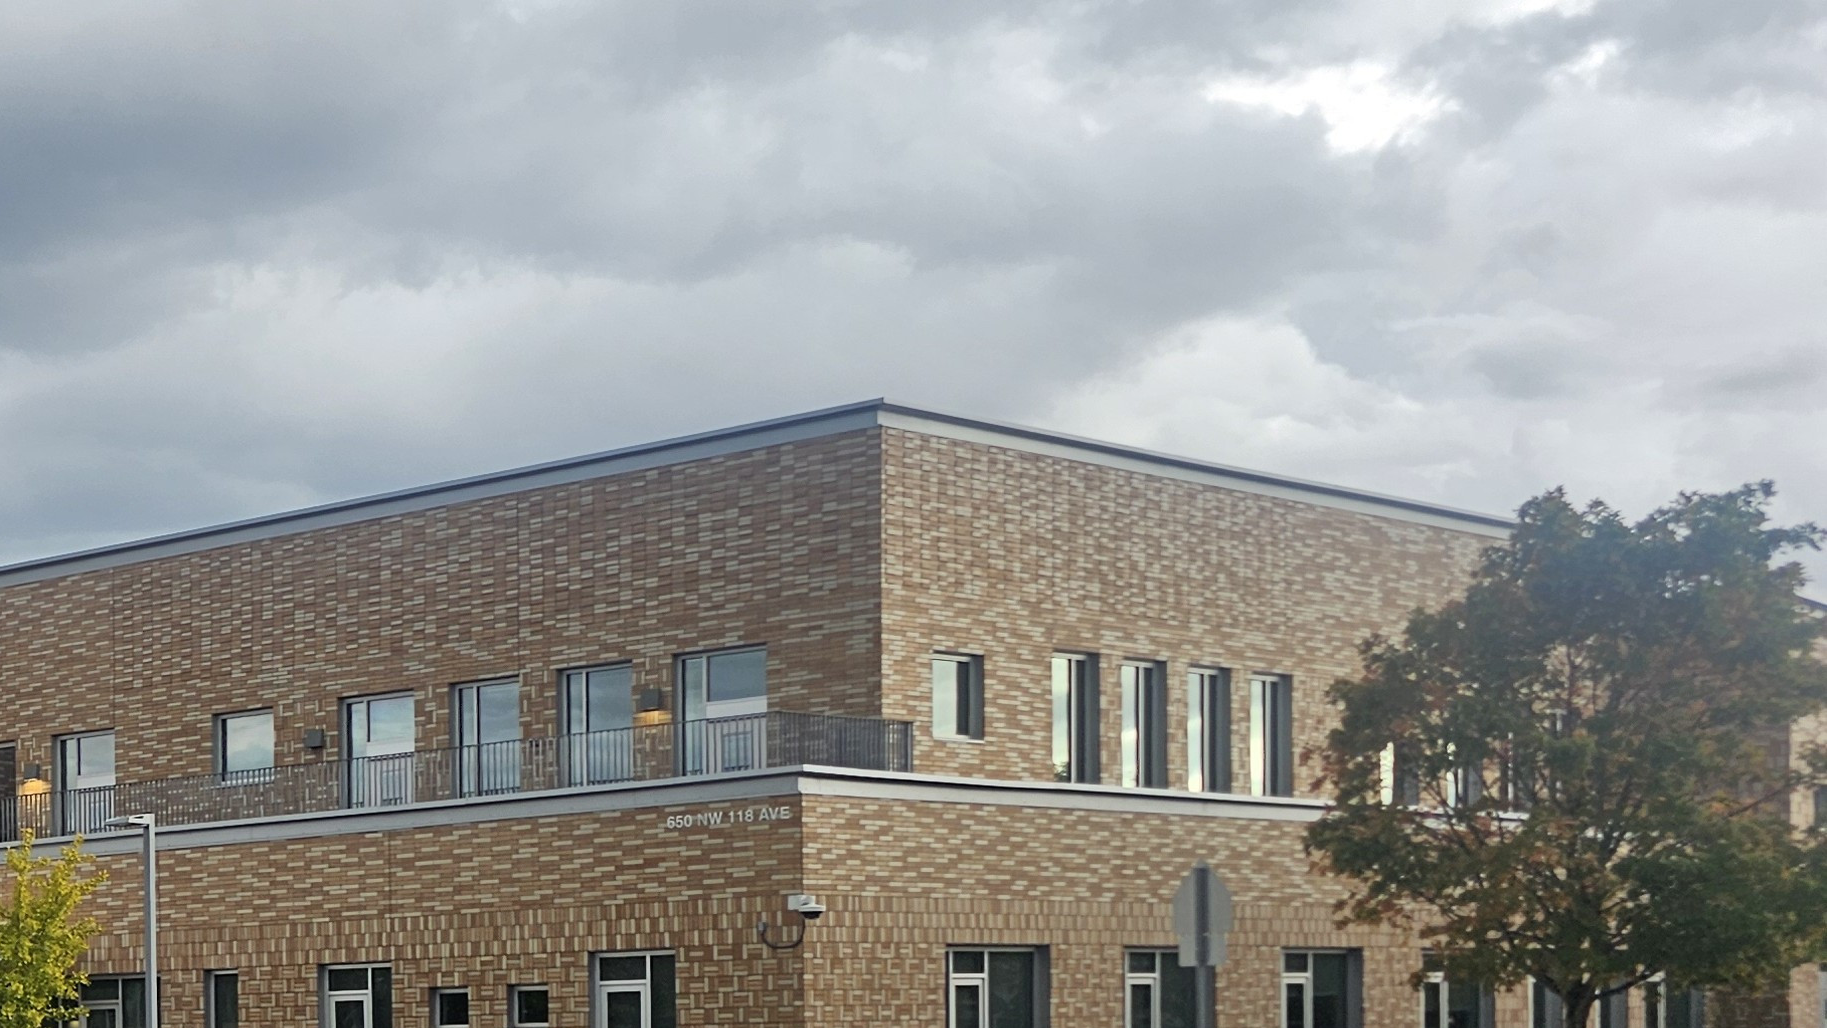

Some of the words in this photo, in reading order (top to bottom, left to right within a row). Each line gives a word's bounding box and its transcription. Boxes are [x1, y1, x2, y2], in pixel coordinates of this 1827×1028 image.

[667, 814, 692, 829] 650
[697, 811, 723, 826] NW
[728, 809, 754, 823] 118
[759, 806, 790, 821] AVE
